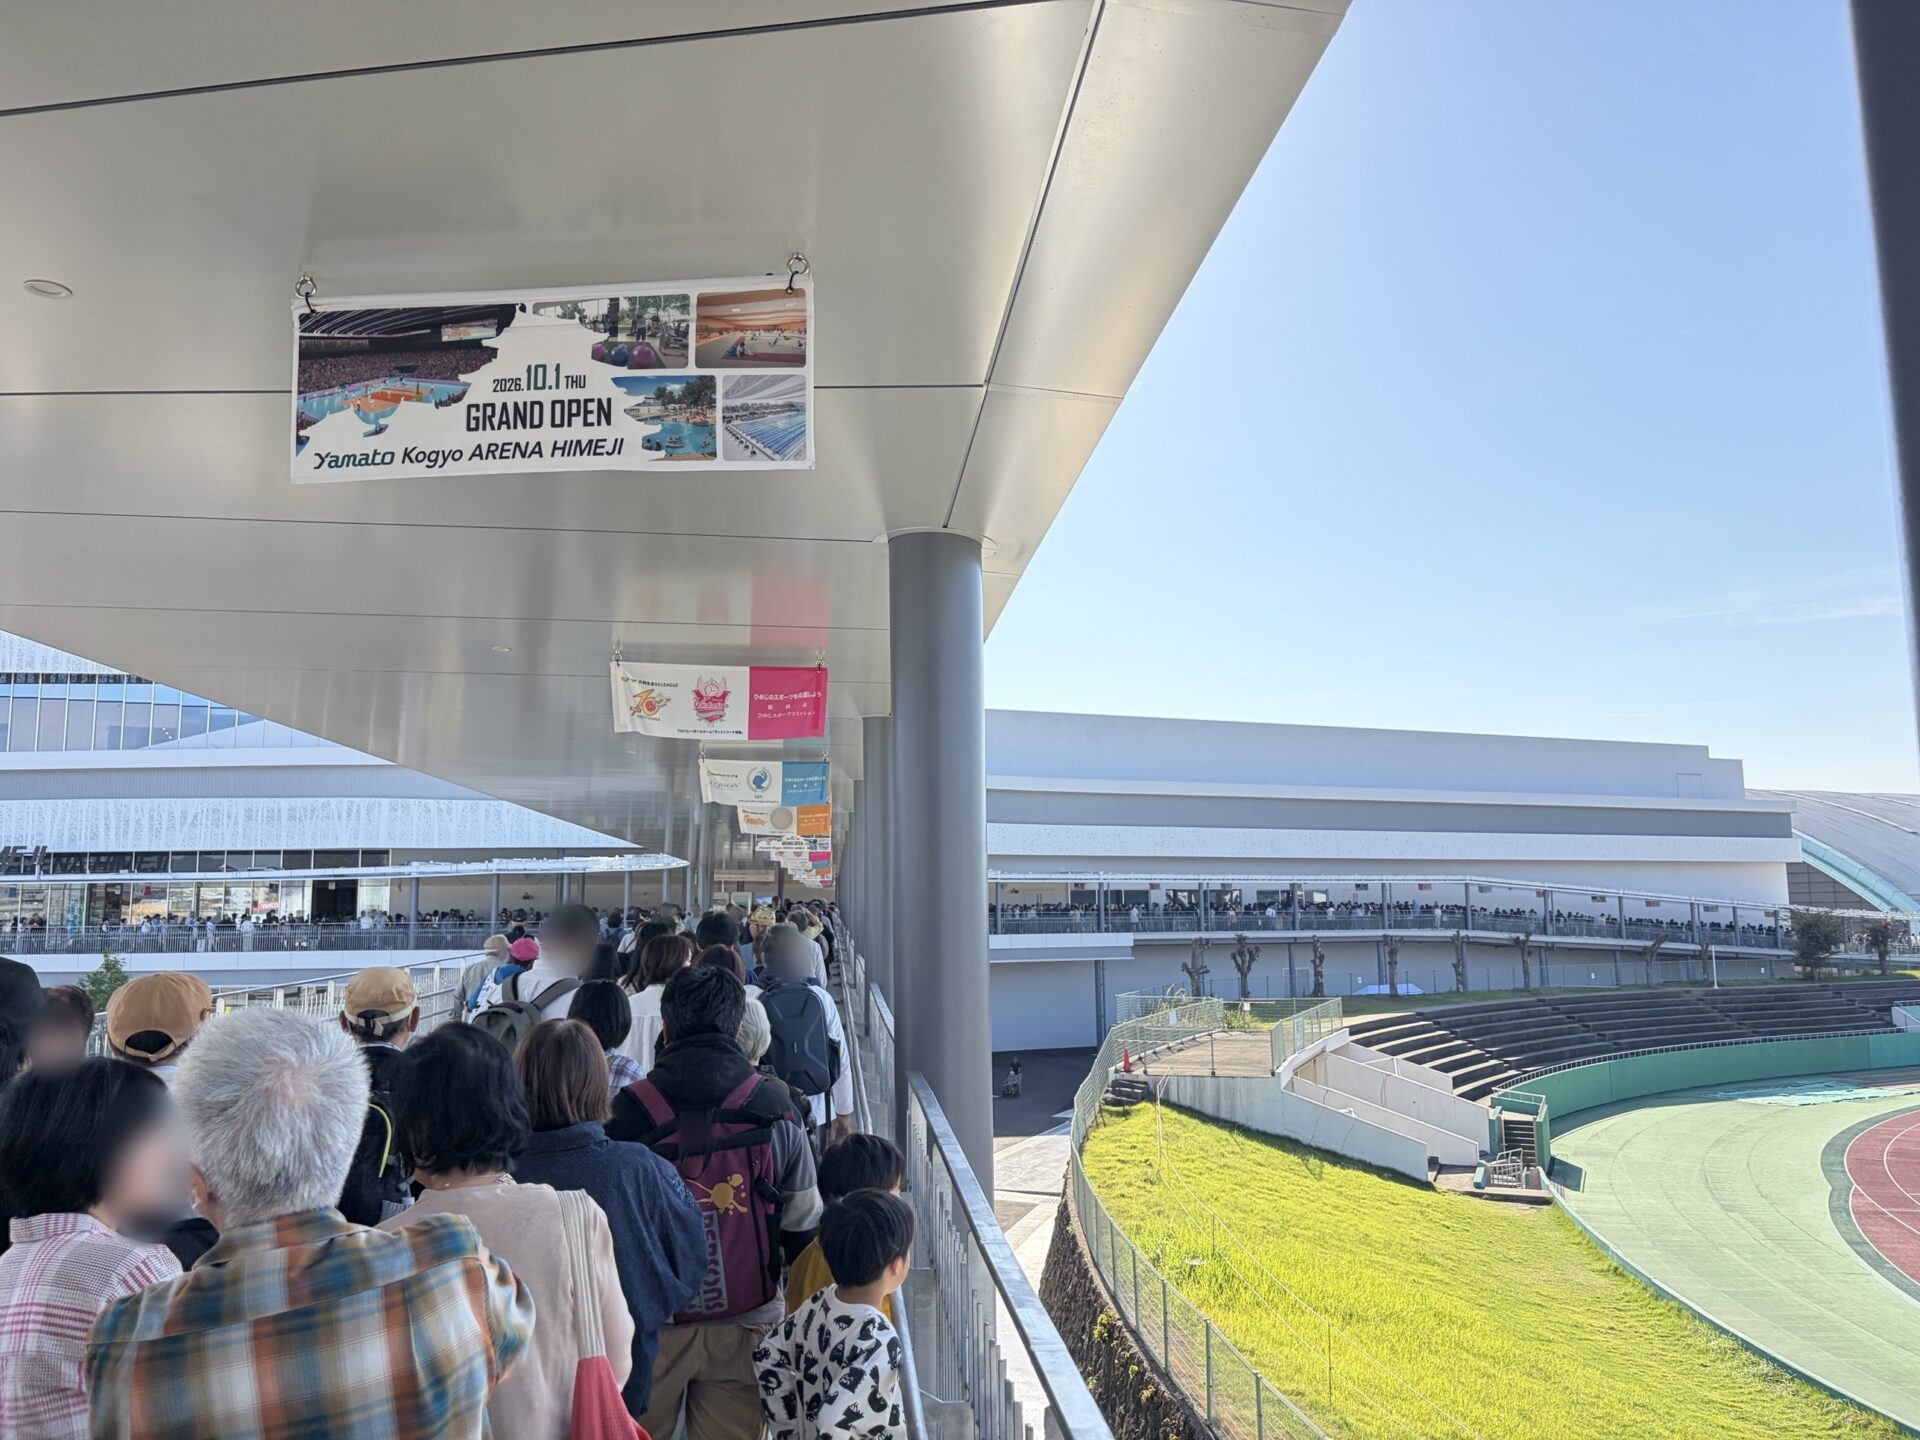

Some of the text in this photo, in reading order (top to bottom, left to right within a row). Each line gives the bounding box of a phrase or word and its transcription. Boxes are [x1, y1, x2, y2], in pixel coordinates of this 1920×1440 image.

[564, 374, 587, 390] THU
[465, 397, 612, 432] GRAND OPEN
[313, 438, 624, 470] Yamato Kogyo ARENA HIMEJI
